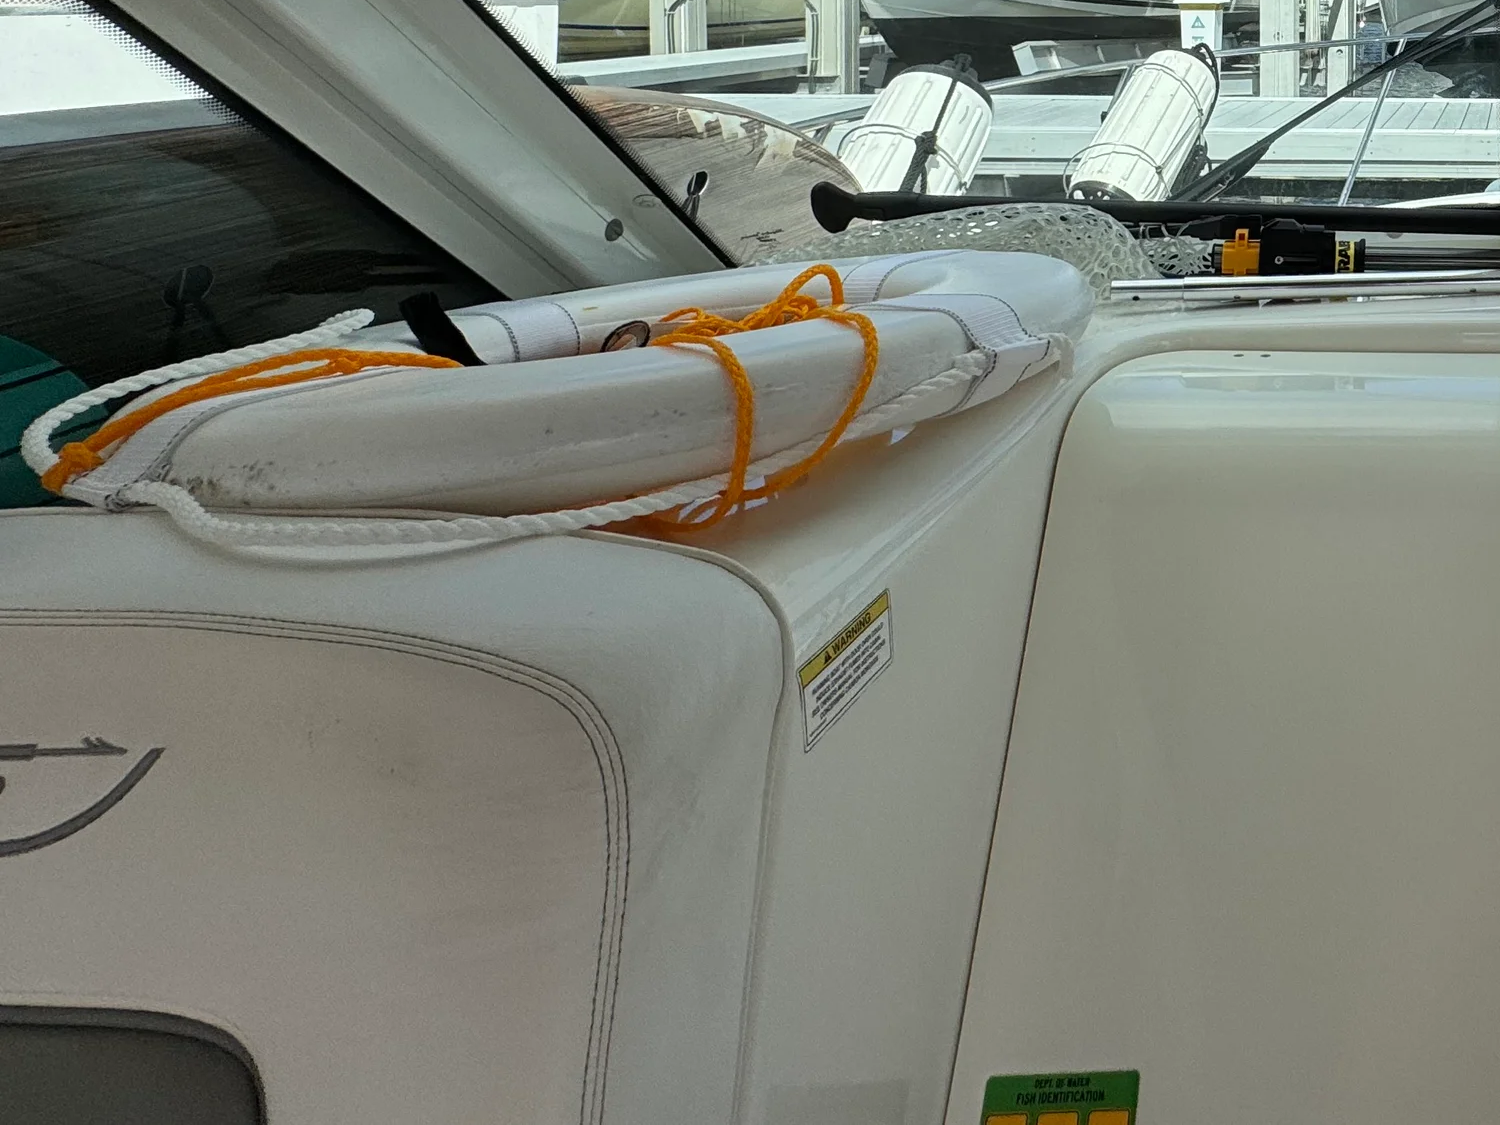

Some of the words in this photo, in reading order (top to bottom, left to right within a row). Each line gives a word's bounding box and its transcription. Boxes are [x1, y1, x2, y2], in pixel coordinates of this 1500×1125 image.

[832, 613, 871, 655] WARNING
[1016, 1092, 1036, 1105] FISH
[1037, 1090, 1105, 1105] IDENTIFICATION
